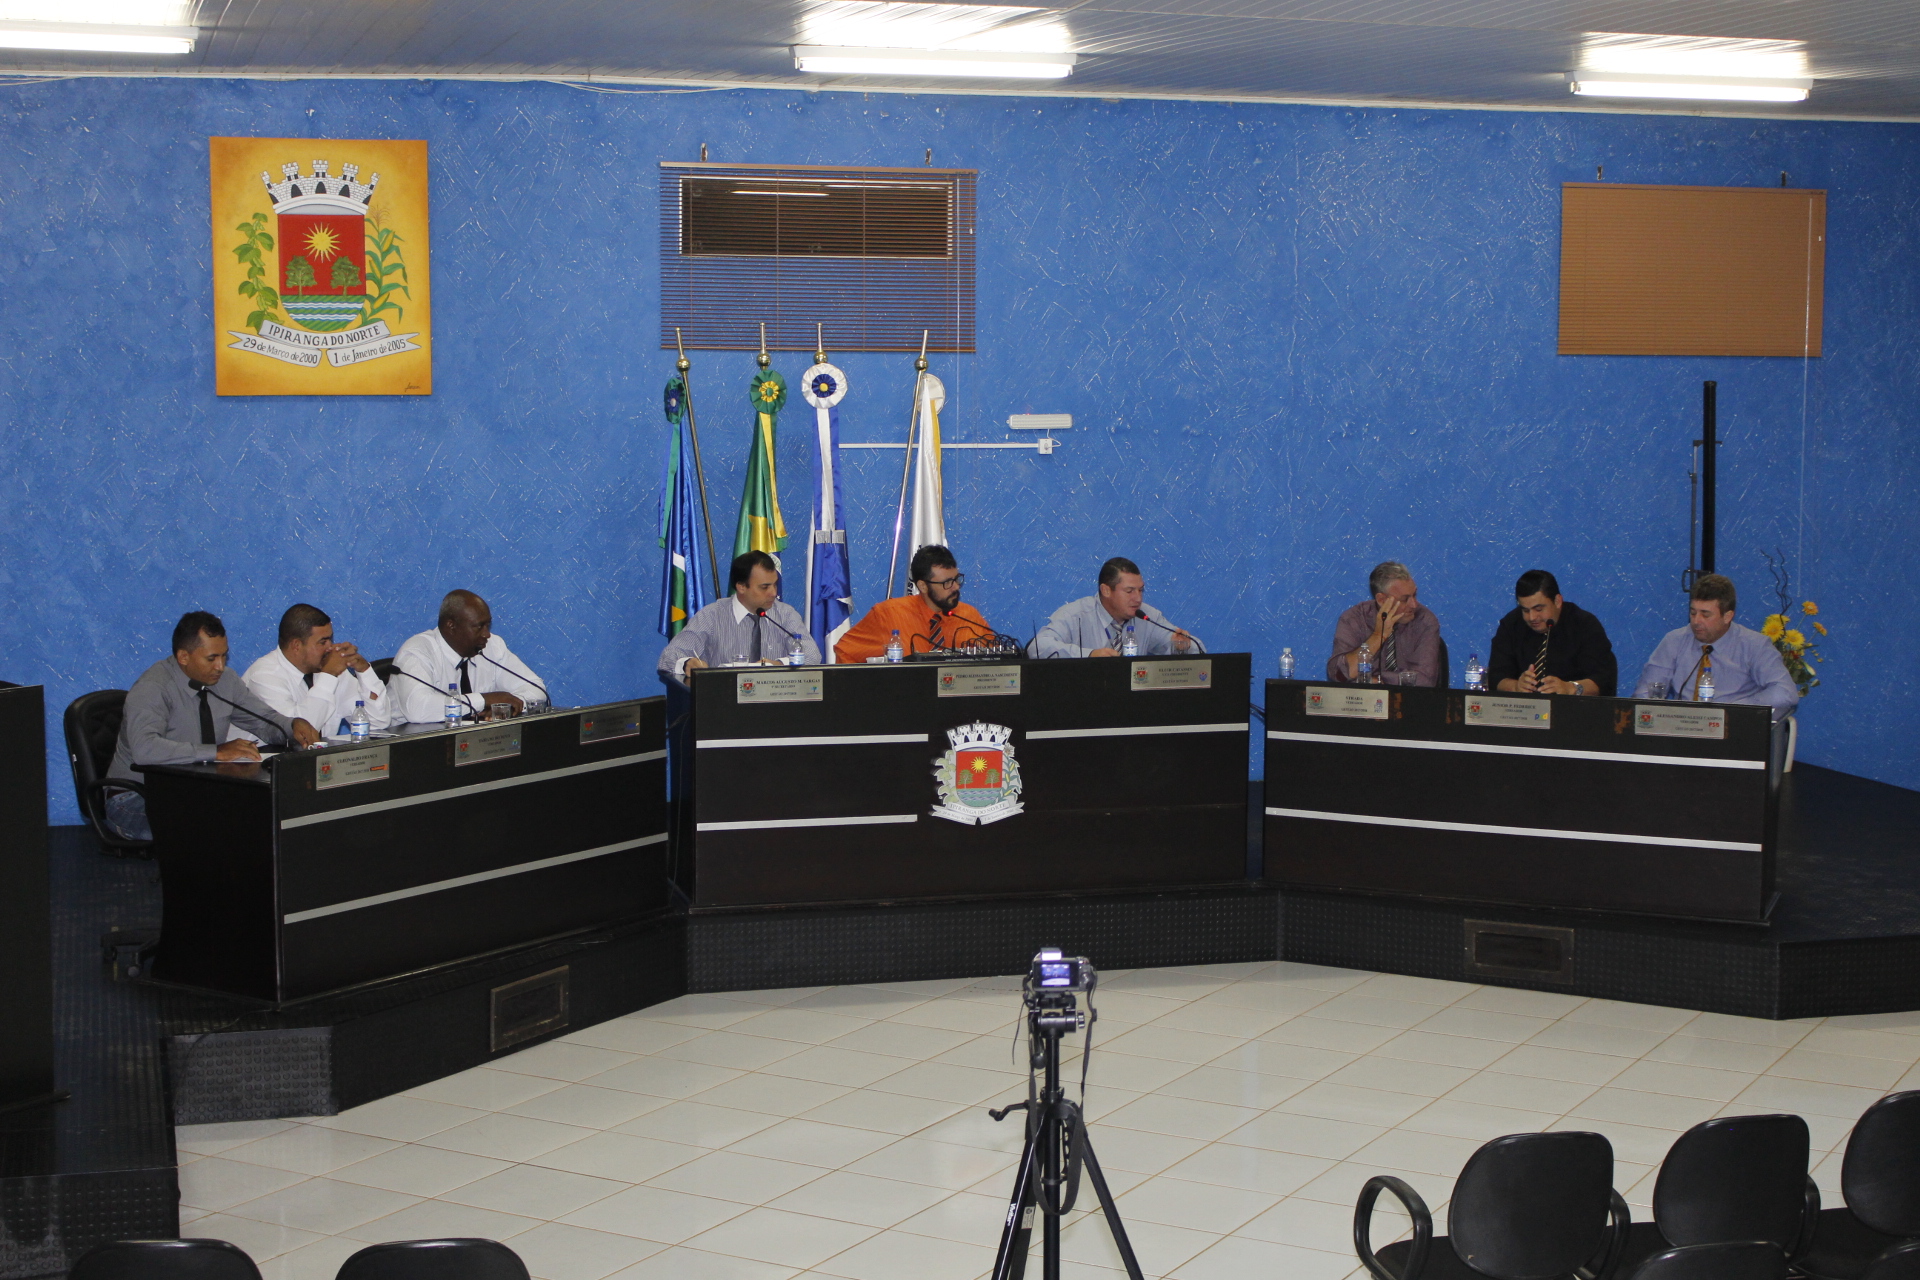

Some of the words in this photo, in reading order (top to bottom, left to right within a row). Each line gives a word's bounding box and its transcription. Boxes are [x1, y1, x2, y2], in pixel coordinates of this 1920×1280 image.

[269, 324, 328, 346] IPIRANGA
[330, 337, 344, 346] DO
[346, 325, 381, 344] NORTE
[243, 338, 257, 349] 29
[256, 342, 266, 351] de
[266, 344, 290, 359] Março
[290, 351, 300, 362] de
[299, 352, 318, 365] 2000
[334, 352, 339, 364] 1
[341, 352, 351, 363] de
[351, 346, 378, 363] Janeiro
[379, 343, 388, 354] de
[387, 338, 406, 352] 2005
[950, 803, 977, 815] IPIRANGA
[987, 803, 1005, 813] NORTE
